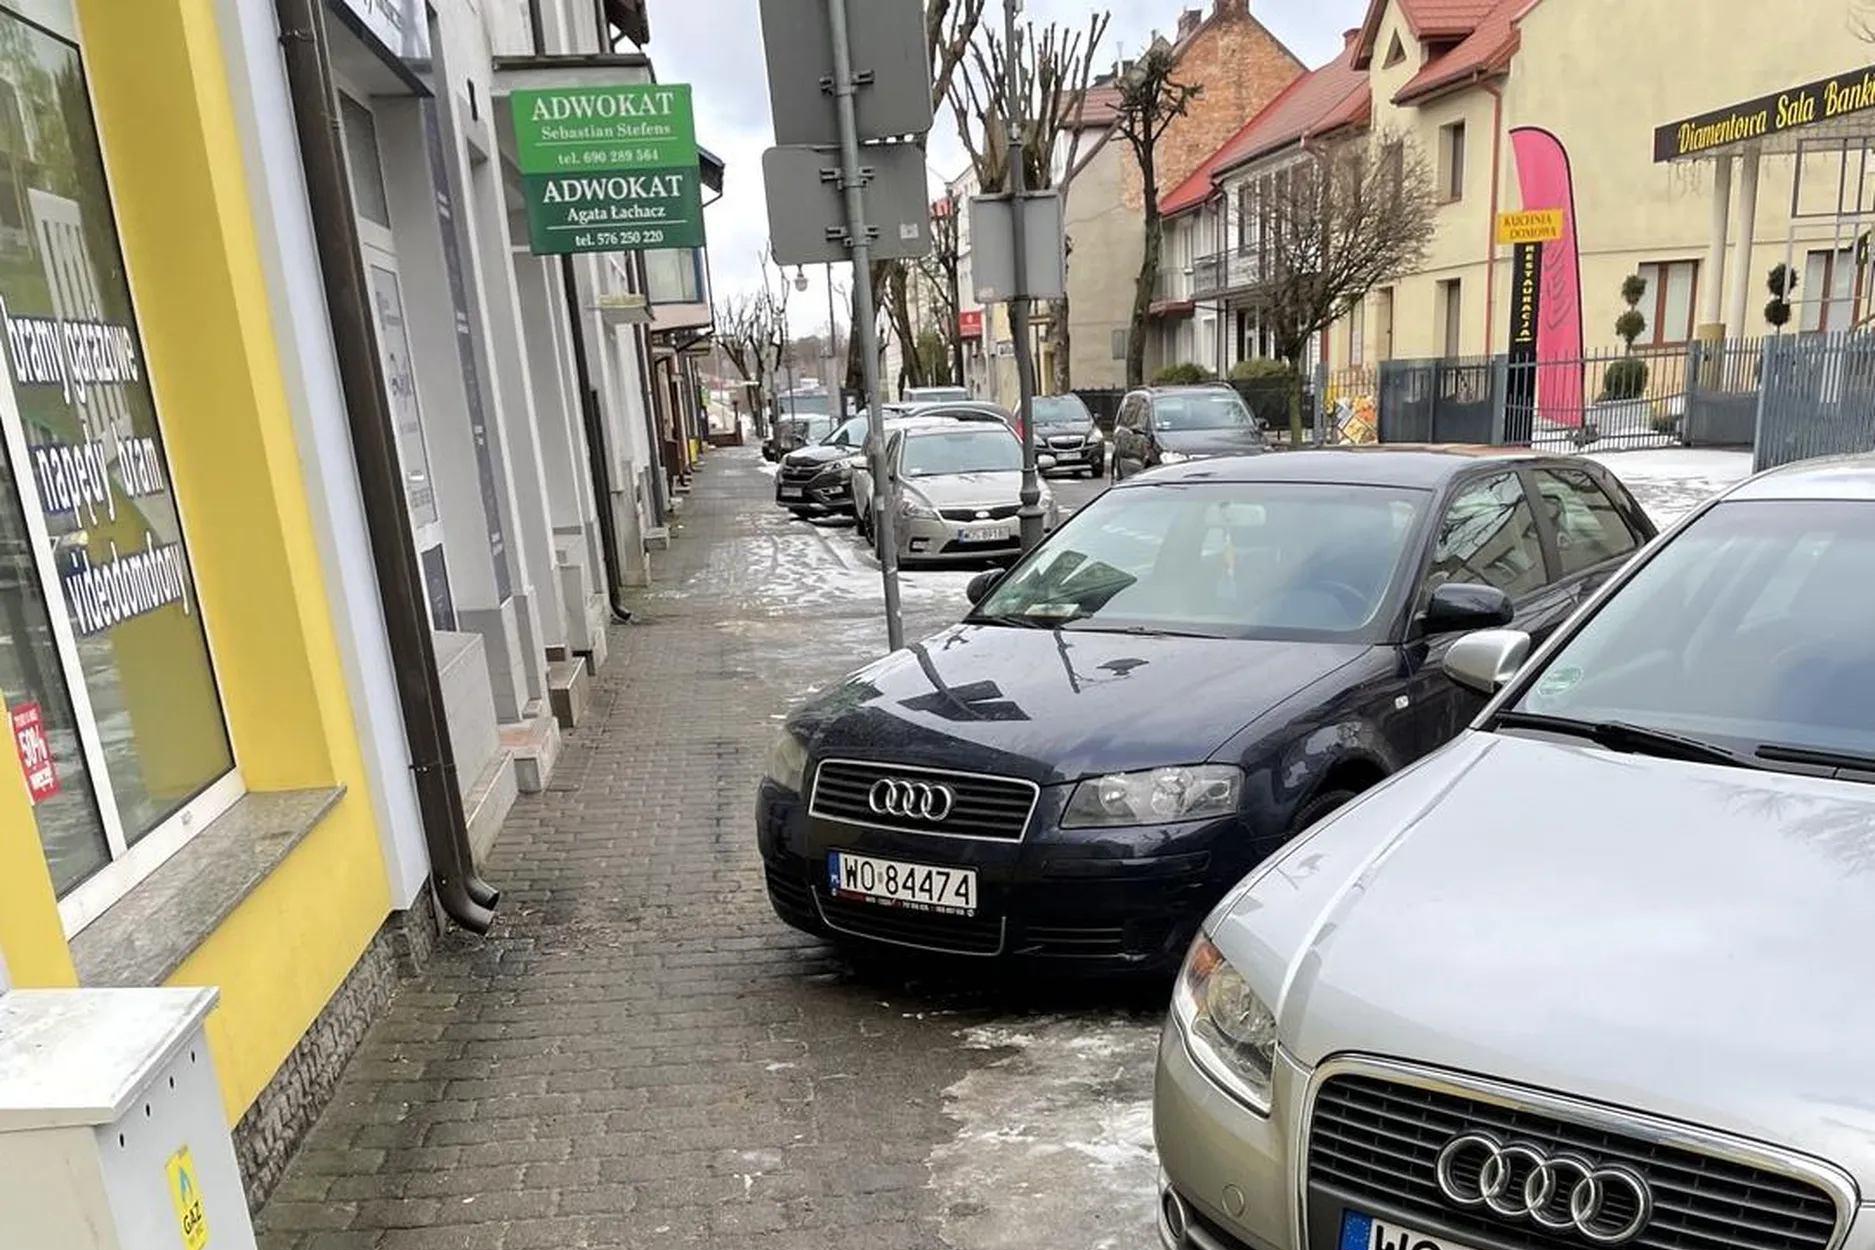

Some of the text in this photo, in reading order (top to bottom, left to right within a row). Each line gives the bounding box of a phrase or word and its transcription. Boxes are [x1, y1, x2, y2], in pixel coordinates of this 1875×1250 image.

[531, 92, 674, 121] ADWOKAT
[541, 122, 671, 140] Sebastian Stefens
[1678, 110, 1768, 154] Diamentowa
[1775, 91, 1816, 129] Sala
[558, 151, 580, 165] tel.
[583, 150, 606, 164] 690
[611, 149, 633, 163] 289
[542, 175, 683, 203] ADWOKAT
[567, 205, 667, 224] Agata Łachacz
[1504, 213, 1552, 226] KUCHNIA
[575, 230, 664, 247] tel. 576 250 220
[1510, 226, 1557, 239] DOMOWA
[1519, 245, 1535, 337] RESTAURACJA
[1, 296, 139, 405] bramy garażowe
[36, 421, 164, 529] napędy bram
[66, 530, 189, 635] videodomofony
[844, 856, 875, 891] WO
[885, 865, 970, 906] 84474
[183, 1200, 202, 1235] GAZ
